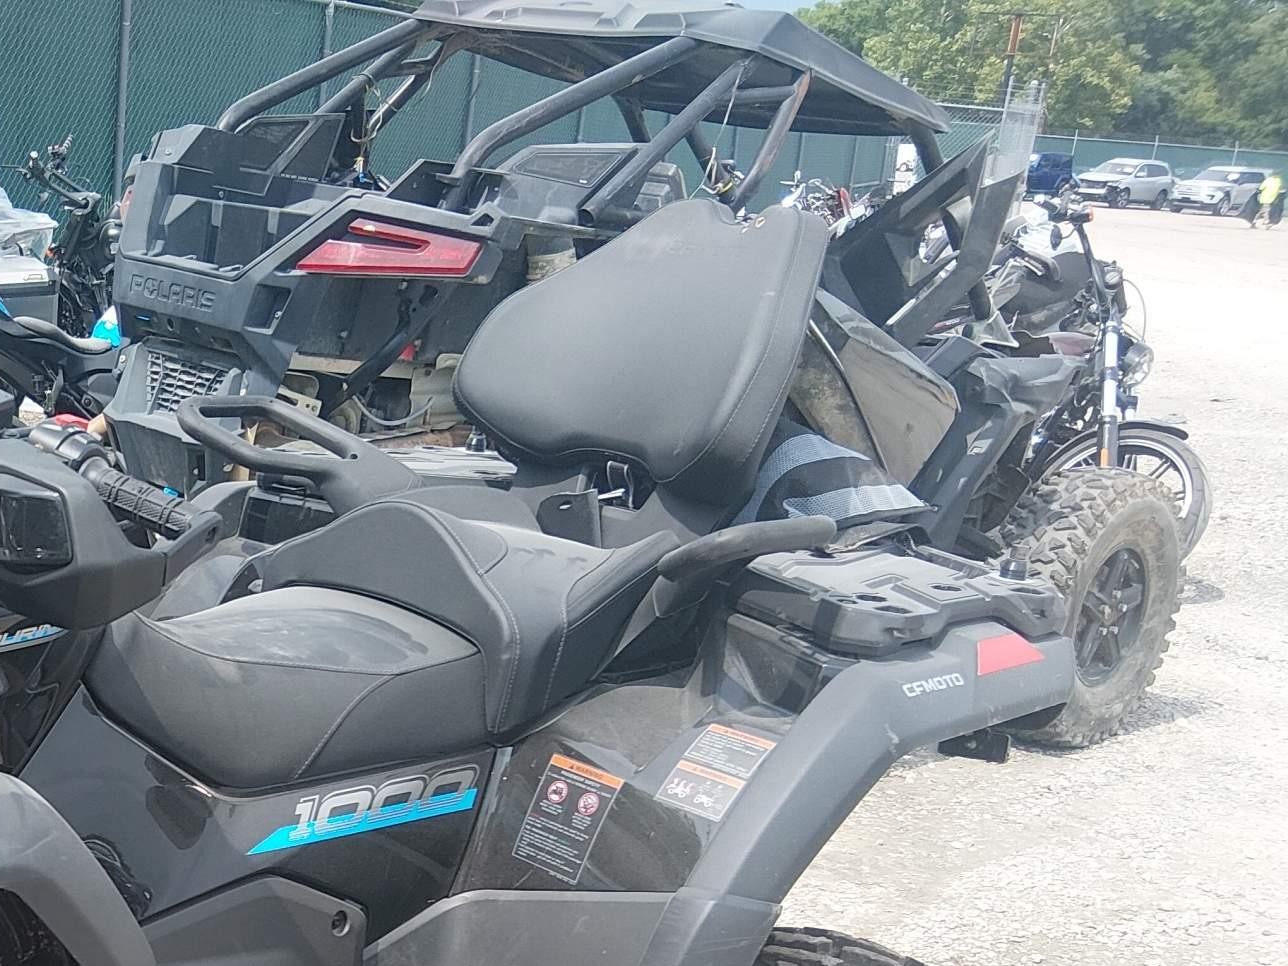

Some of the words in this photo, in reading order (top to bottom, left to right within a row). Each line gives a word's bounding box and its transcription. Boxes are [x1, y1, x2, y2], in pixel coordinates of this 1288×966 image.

[130, 273, 217, 312] POLARIS
[902, 673, 965, 697] CFMOTO
[289, 764, 480, 841] 1000
